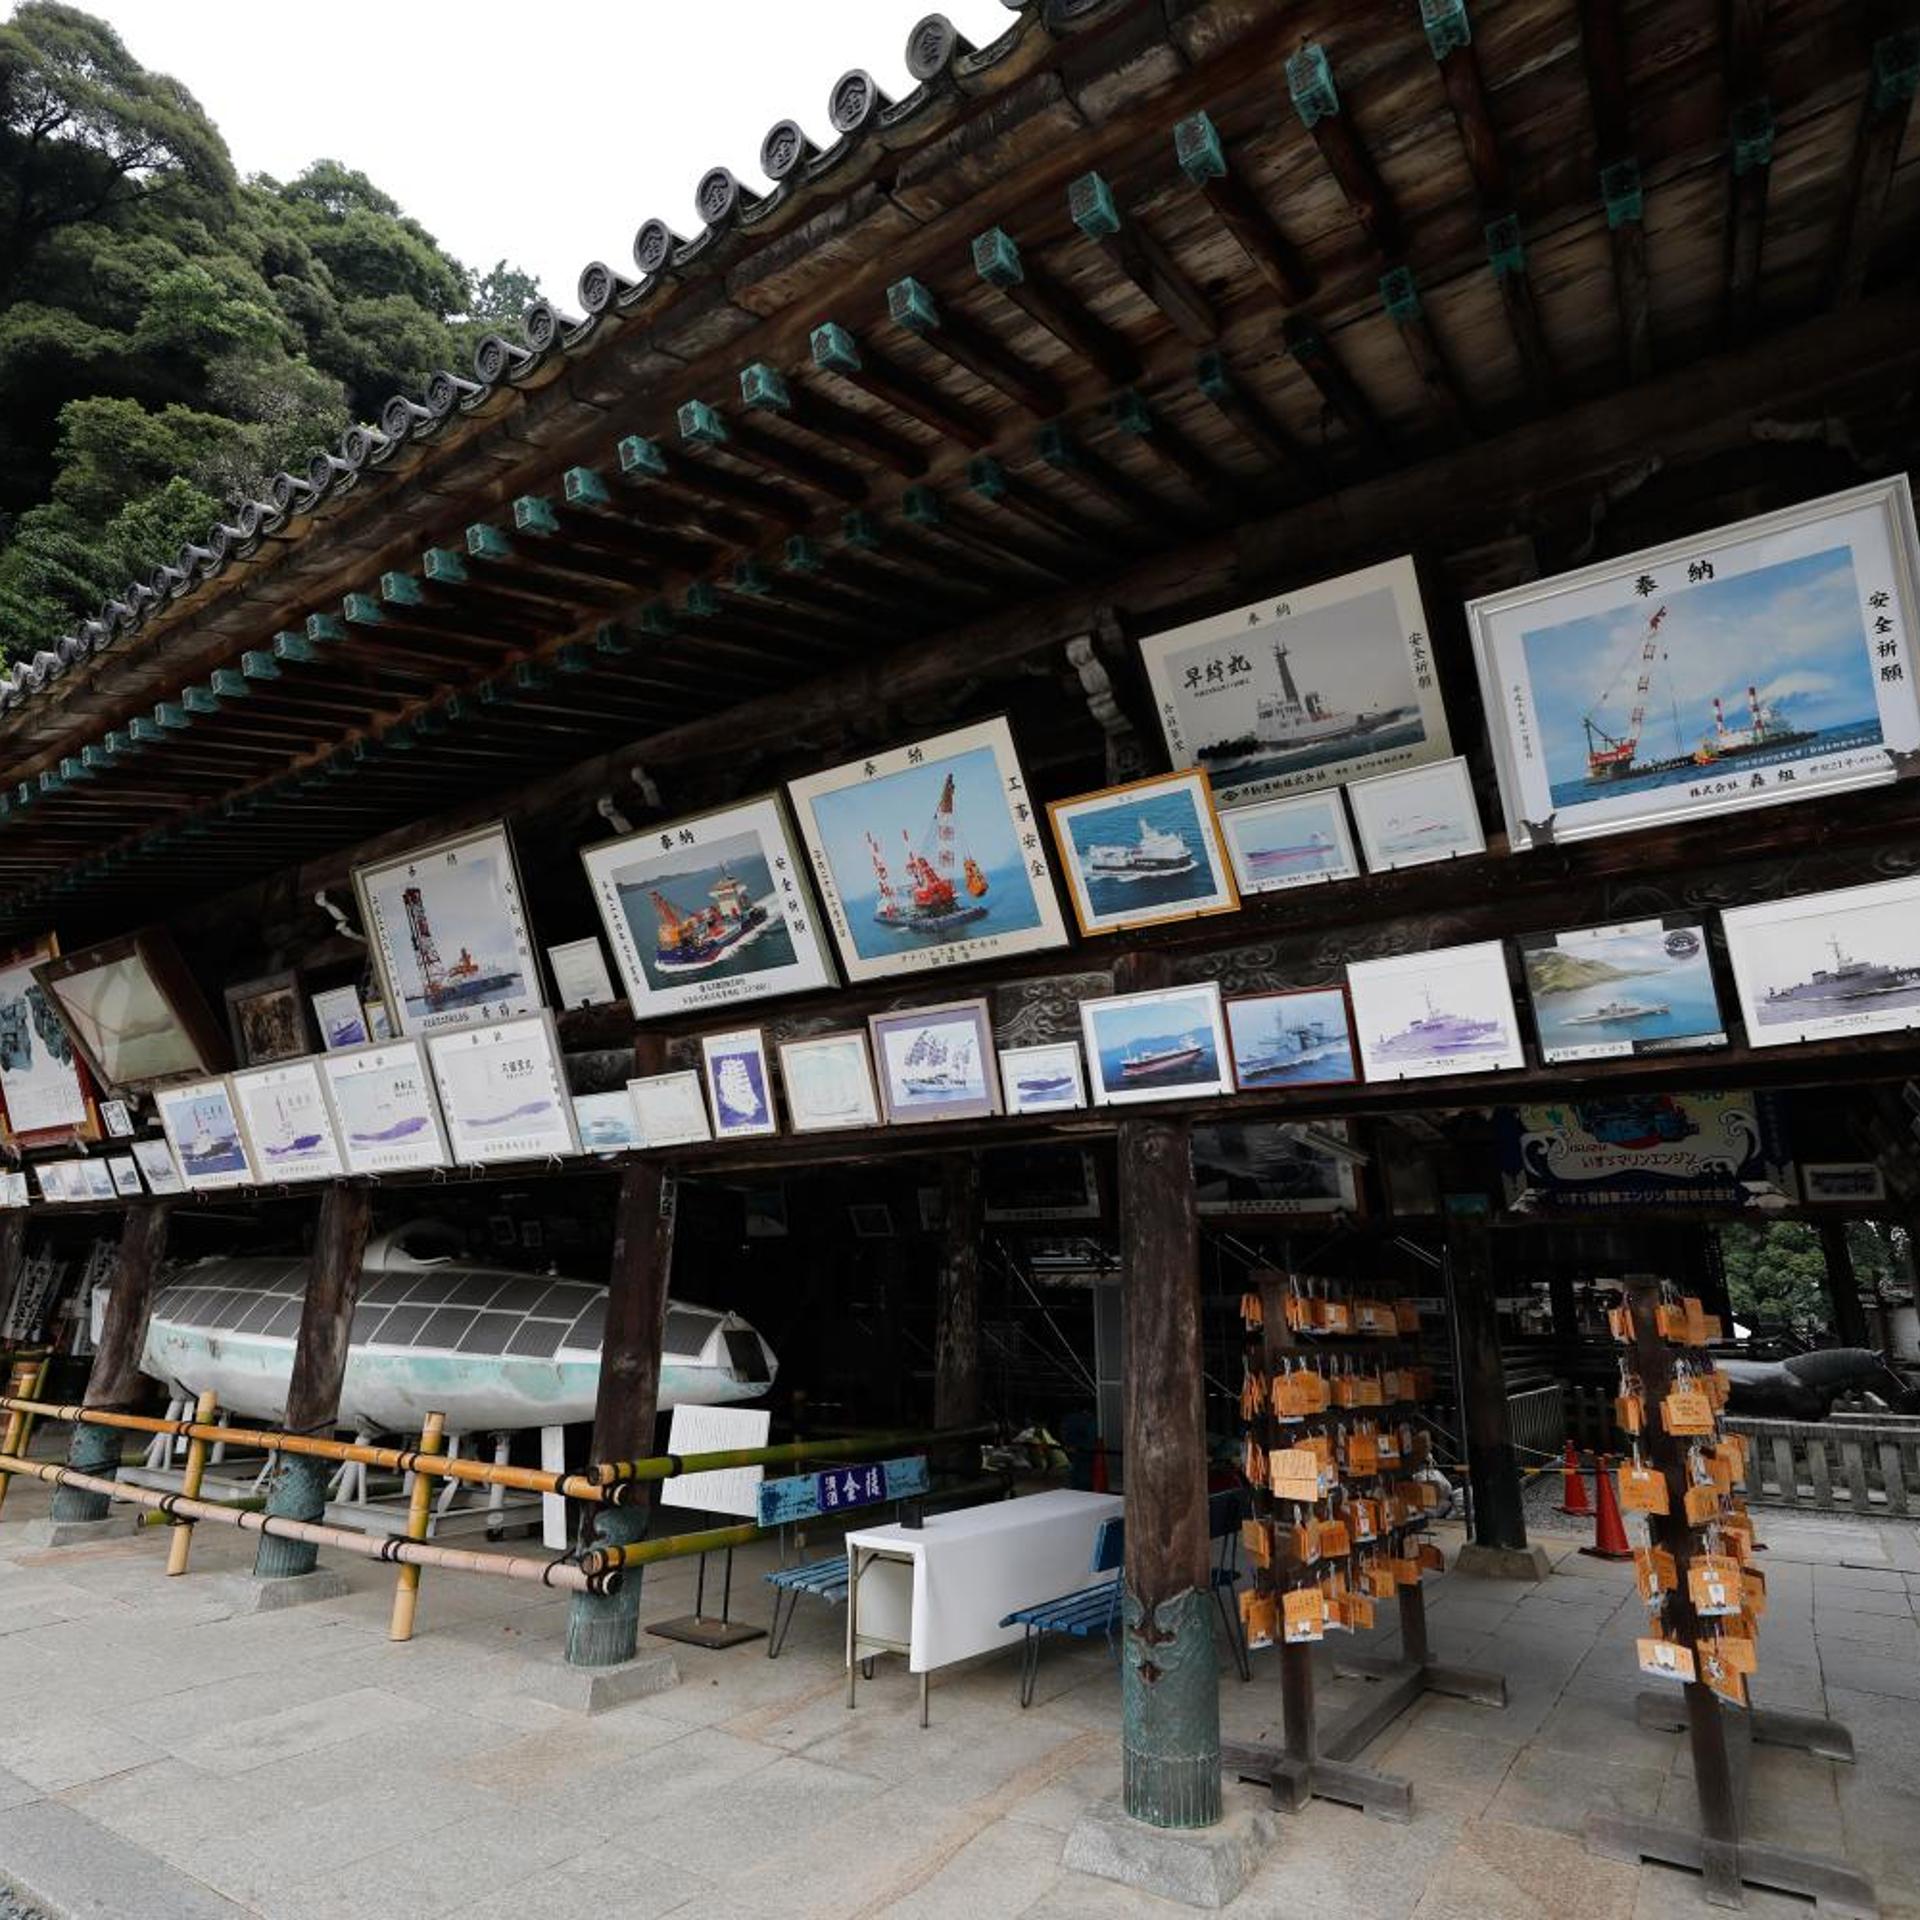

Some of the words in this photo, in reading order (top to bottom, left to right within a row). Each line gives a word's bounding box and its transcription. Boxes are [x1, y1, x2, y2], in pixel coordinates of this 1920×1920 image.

[1634, 560, 1715, 597] 奉納
[1868, 591, 1903, 681] 安全祈願
[1409, 632, 1432, 690] 安全祈願
[862, 747, 924, 777] 奉納
[1689, 780, 1740, 798] 株式会社
[659, 829, 696, 851] 奉納
[1008, 776, 1047, 878] 工事安全
[775, 855, 808, 937] 安全祈願
[841, 1464, 882, 1502] 金陵
